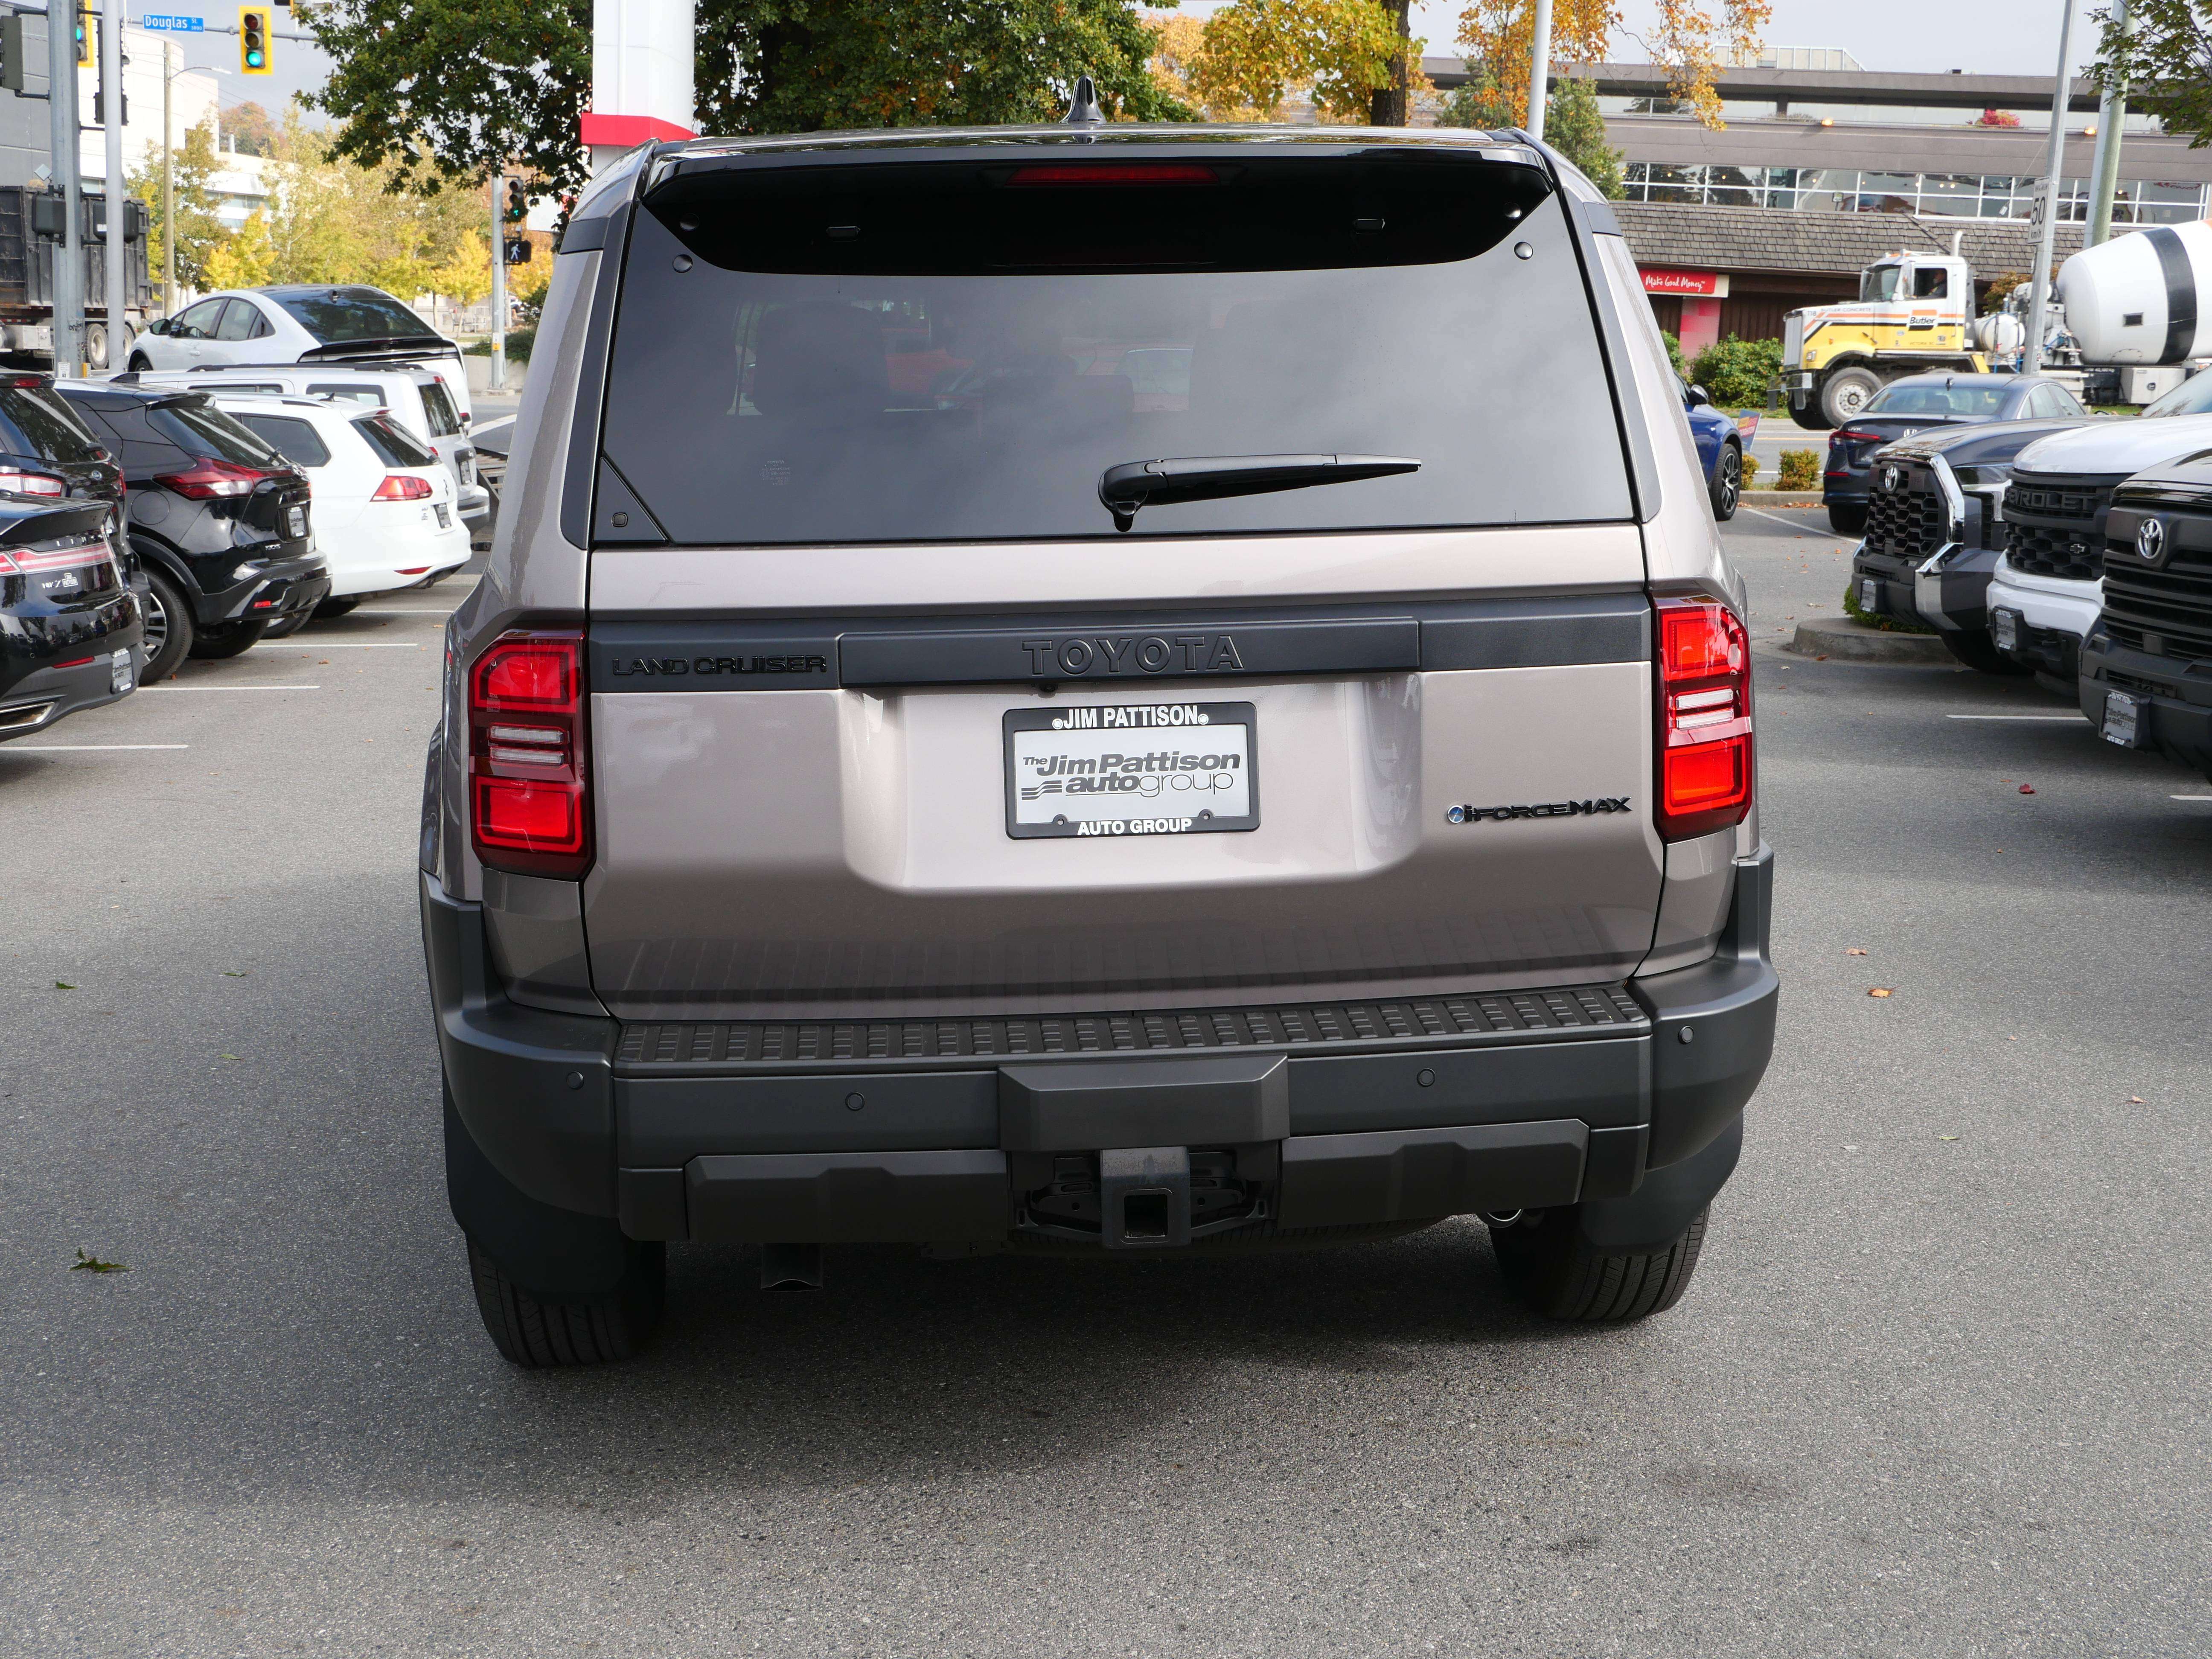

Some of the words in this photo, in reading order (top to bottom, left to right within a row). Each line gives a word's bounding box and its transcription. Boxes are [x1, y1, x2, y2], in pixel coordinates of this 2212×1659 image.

[146, 15, 187, 30] Douglas
[2032, 196, 2045, 226] 50
[2031, 229, 2041, 239] km/h
[1645, 275, 1663, 288] Make
[1665, 276, 1679, 287] Good
[1022, 635, 1245, 676] TOYOTA
[613, 658, 689, 675] LAND
[693, 655, 827, 674] CRUISER
[1063, 708, 1097, 729] JIM
[1103, 705, 1197, 727] PATTISON
[2107, 734, 2115, 742] AUTO
[1077, 820, 1125, 835] AUTO
[1129, 818, 1192, 833] GROUP
